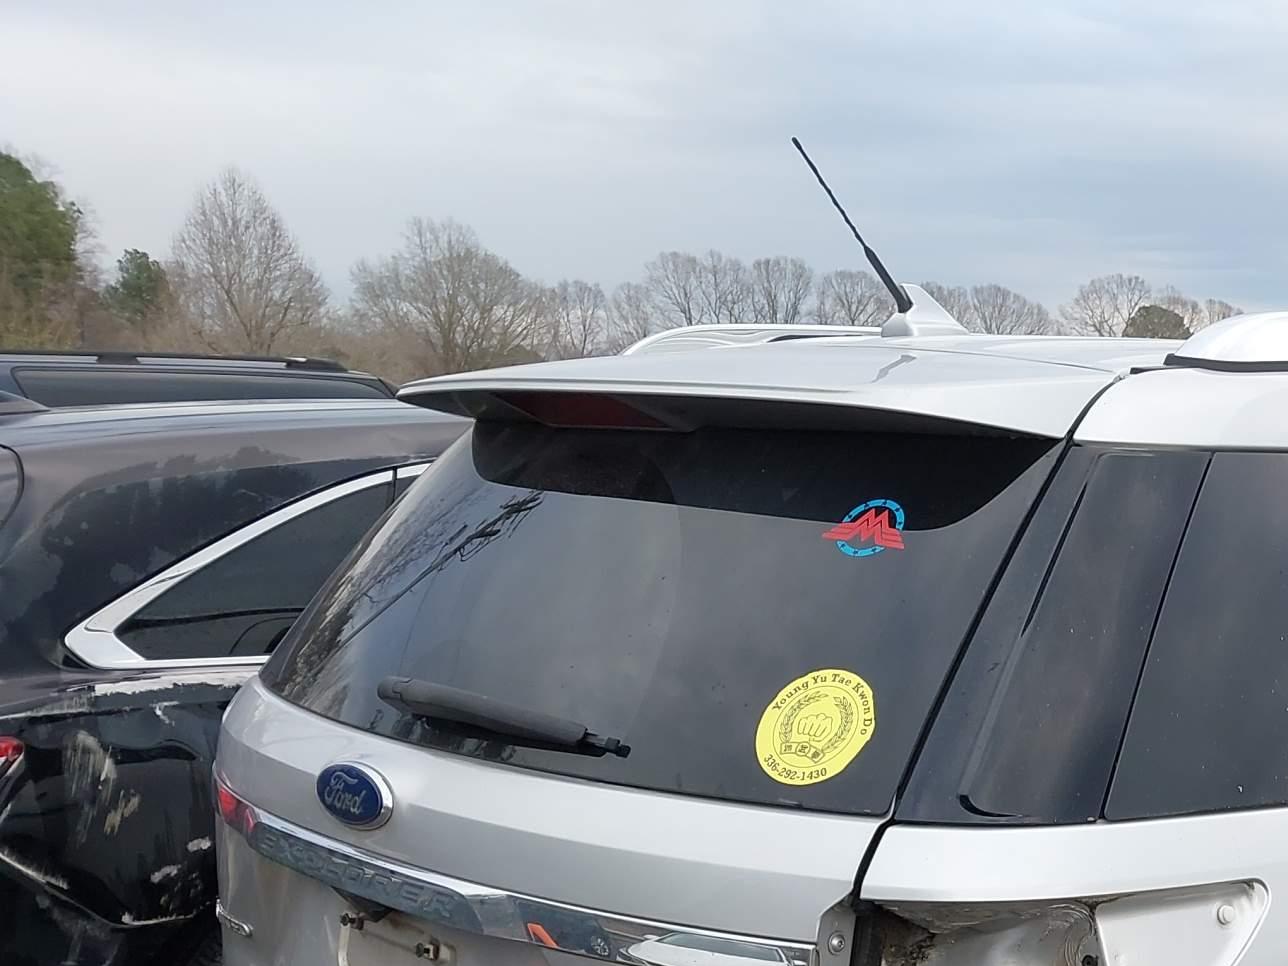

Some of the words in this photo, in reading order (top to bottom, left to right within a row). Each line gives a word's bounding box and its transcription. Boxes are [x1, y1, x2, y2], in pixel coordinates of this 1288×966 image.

[811, 674, 828, 685] Yu
[831, 673, 852, 687] Tae
[772, 680, 810, 712] Young
[851, 682, 872, 716] Kwon
[859, 717, 873, 736] Do
[763, 753, 828, 782] 336-292-1430
[324, 771, 367, 815] Ford
[259, 833, 456, 916] EXPLORER
